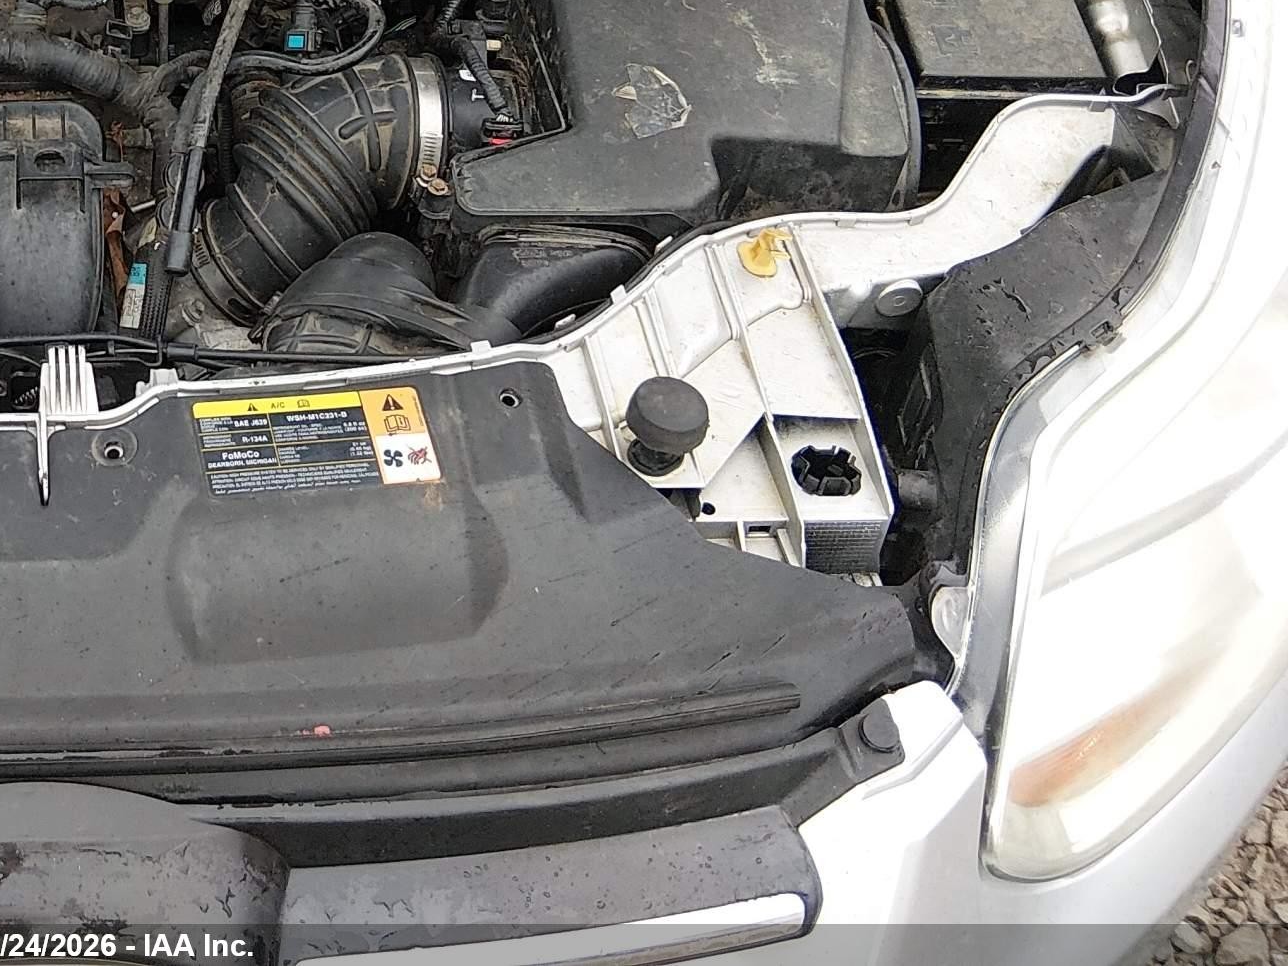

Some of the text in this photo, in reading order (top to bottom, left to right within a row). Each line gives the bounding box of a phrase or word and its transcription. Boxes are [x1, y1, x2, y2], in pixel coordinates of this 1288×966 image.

[234, 419, 249, 427] SAE
[251, 418, 268, 426] J639
[242, 435, 269, 443] R-134A
[222, 450, 260, 460] FoMoCo
[207, 457, 277, 469] DEARBORN, MICHIGAN
